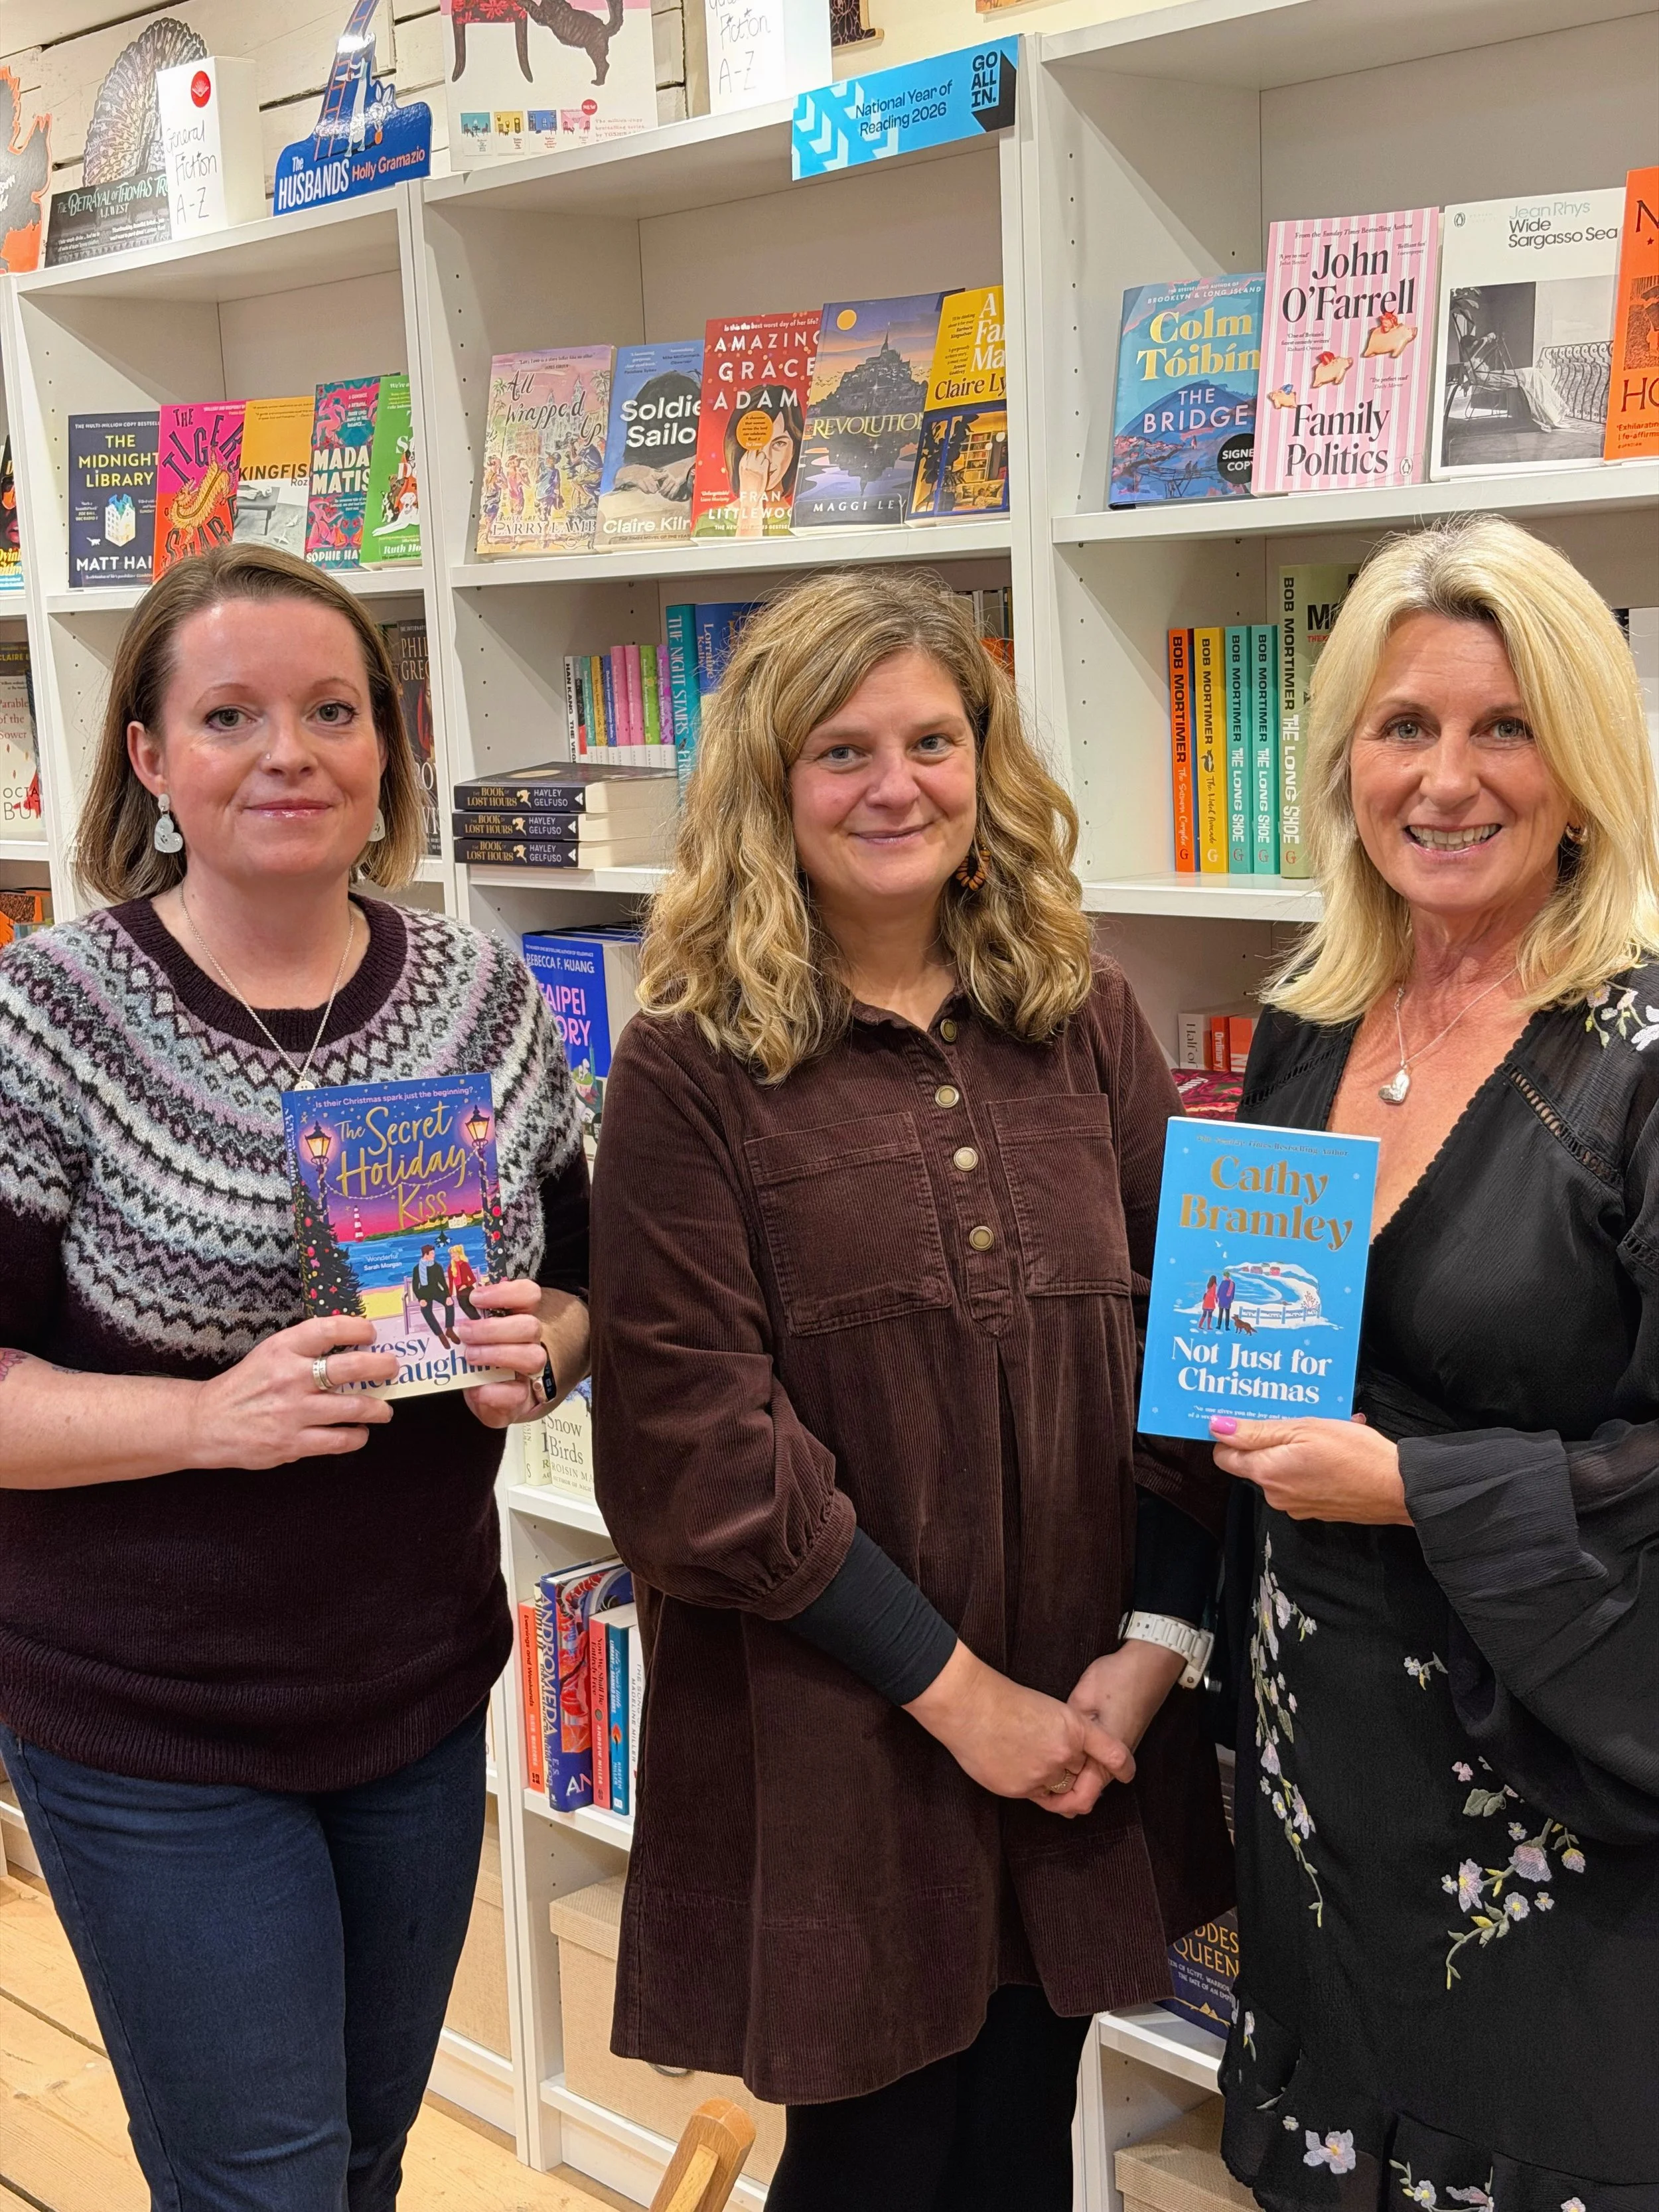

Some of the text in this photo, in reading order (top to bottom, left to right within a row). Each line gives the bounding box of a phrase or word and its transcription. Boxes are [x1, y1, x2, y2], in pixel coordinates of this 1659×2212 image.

[973, 51, 998, 72] GO
[971, 69, 997, 91] ALL
[855, 79, 953, 119] National Year of
[971, 88, 997, 108] IN.
[860, 102, 947, 137] Reading 2026
[292, 156, 304, 172] The
[278, 145, 425, 212] HUSBANDS Holly Gramazio
[1508, 206, 1551, 220] Jean
[1553, 201, 1591, 218] Rhys
[1508, 218, 1551, 234] Wide
[1508, 226, 1619, 250] Sargasso Sea
[1312, 240, 1388, 280] John
[978, 292, 997, 319] A
[1147, 293, 1191, 304] BROOKLYN
[1230, 286, 1262, 295] ISLAND
[1282, 278, 1414, 324] O’Farrell
[779, 321, 789, 329] day
[1150, 307, 1253, 344] Colm
[718, 357, 815, 382] GRACE
[1136, 342, 1260, 382] Tóibín
[507, 370, 536, 402] All
[934, 377, 985, 401] Claire
[1179, 388, 1216, 406] THE
[506, 390, 586, 429] Wrapped
[712, 388, 798, 411] ADAM
[173, 408, 194, 427] THE
[1144, 404, 1249, 434] BRIDGE
[1291, 400, 1390, 443] Family
[105, 434, 136, 449] THE
[78, 452, 159, 469] MIDNIGHT
[1284, 441, 1389, 478] Politics
[239, 463, 308, 482] KINGFIS
[290, 477, 309, 487] Roz
[739, 490, 782, 503] FRAN
[493, 520, 596, 536] LARRY LAMB
[603, 516, 656, 534] Claire
[306, 550, 343, 563] SOPHIE
[384, 544, 406, 555] Ruth
[76, 556, 120, 571] MATT
[668, 615, 689, 735] THE NIGHT STAIRS
[9, 713, 25, 724] the
[1282, 577, 1300, 844] BOB MORTIMER THE LONG SHOE
[1173, 636, 1188, 848] BOB MORTIMER Complex
[1201, 638, 1216, 845] BOB MORTIMER The Hotel Avocado
[1231, 635, 1245, 843] BOB MORTIMER THE LONG SHOE
[1258, 634, 1270, 844] BOB MORTIMER THE LONG SHOE
[467, 796, 517, 806] LOST HOURS
[481, 787, 504, 796] BOOK
[534, 788, 562, 797] HAYLEY
[534, 798, 569, 807] GELFUSO
[465, 824, 513, 834] LOST HOURS
[478, 814, 500, 824] BOOK
[529, 826, 562, 835] GELFUSO
[467, 851, 514, 861] LOST HOURS
[480, 841, 502, 851] BOOK
[530, 853, 562, 862] GELFUSO
[526, 952, 595, 974] REBECCA F. KUANG
[323, 1099, 342, 1108] their
[342, 1095, 382, 1106] Christmas
[383, 1094, 403, 1104] spark
[403, 1092, 418, 1102] just
[433, 1086, 474, 1097] beginning?
[334, 1100, 453, 1156] The Secret
[336, 1140, 467, 1197] Holiday
[1210, 1154, 1329, 1206] Cathy
[397, 1181, 448, 1230] Kiss
[1178, 1193, 1354, 1252] Bramley
[380, 1262, 403, 1271] Morgan
[1171, 1336, 1333, 1376] Not Just for
[1178, 1366, 1320, 1404] Christmas
[547, 1414, 582, 1437] Snow
[549, 1436, 584, 1465] Birds
[540, 1592, 558, 1735] ANDROMEDA
[599, 1694, 605, 1706] Be
[1173, 1937, 1240, 1977] QUEEN
